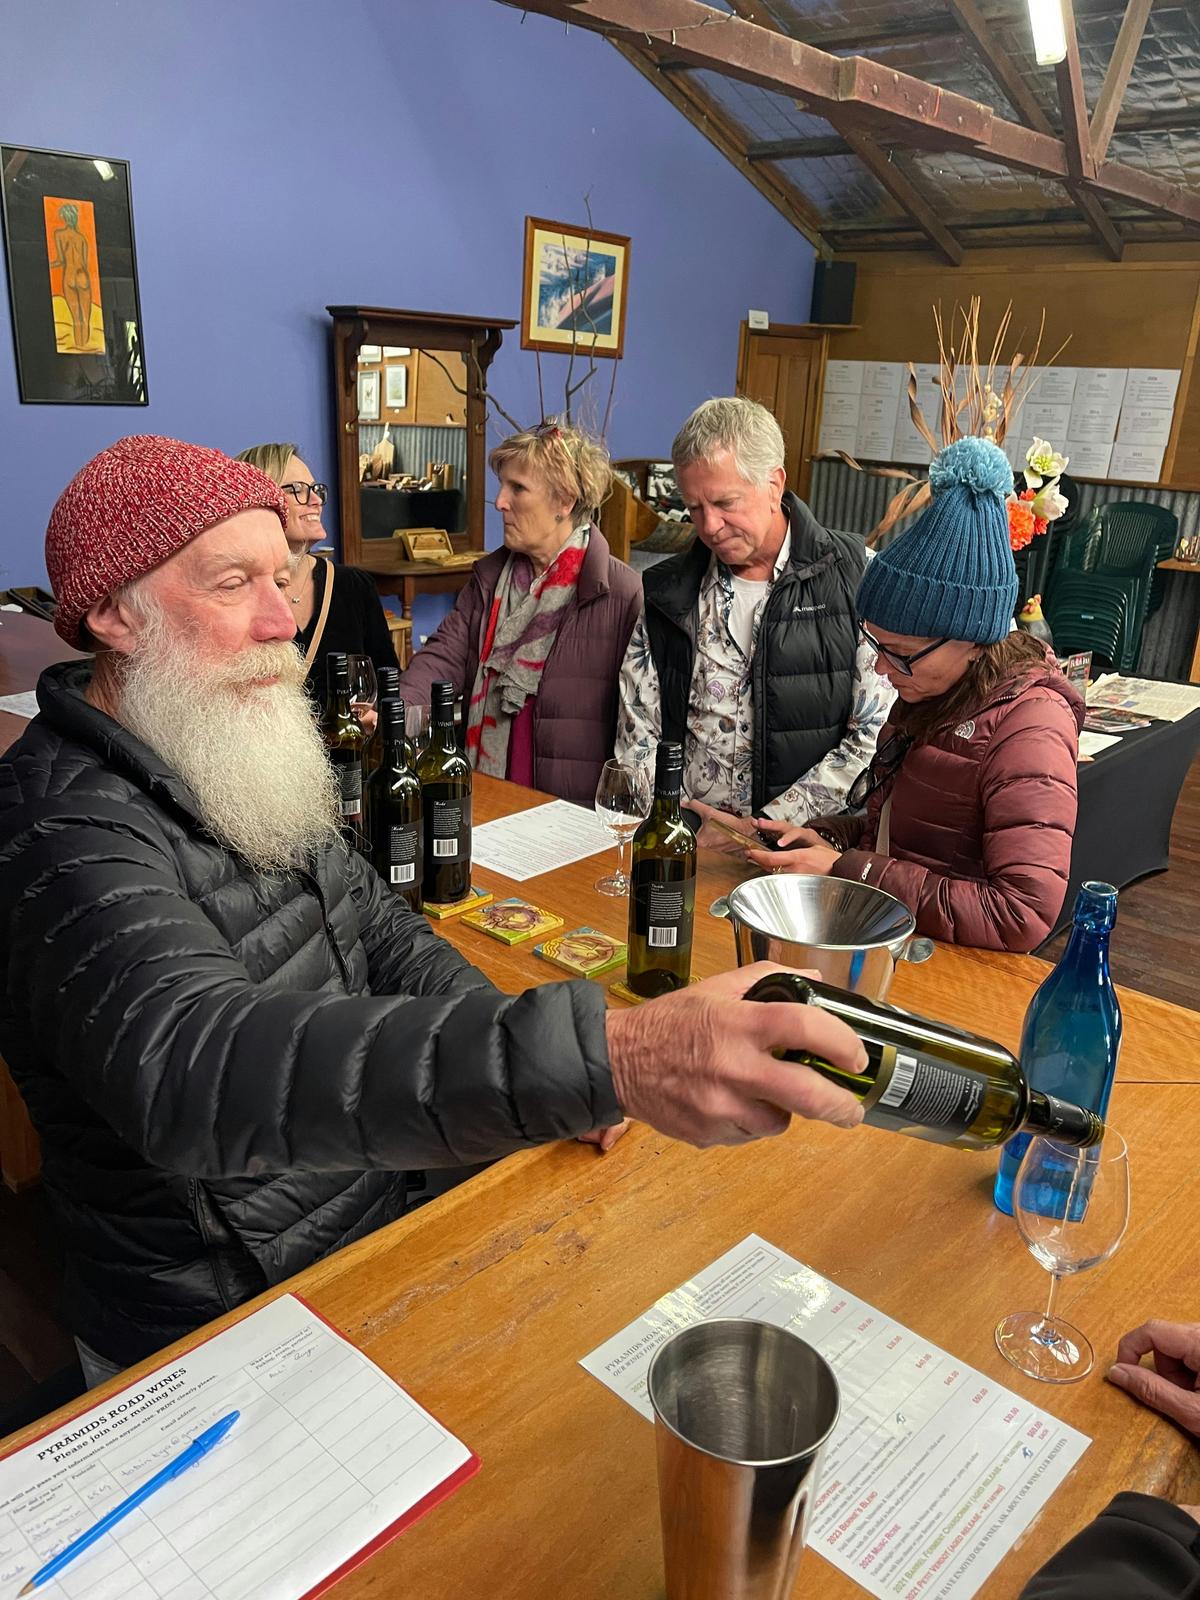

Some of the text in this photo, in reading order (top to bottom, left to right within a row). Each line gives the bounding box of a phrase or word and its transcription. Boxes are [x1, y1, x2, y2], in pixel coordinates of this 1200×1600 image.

[36, 1366, 188, 1461] PYRAMIDS ROAD WINES
[155, 1399, 176, 1414] PRINT
[53, 1378, 186, 1463] Please join our mailing list
[159, 1418, 177, 1431] Email
[812, 1477, 842, 1512] OURVEDRE
[826, 1528, 842, 1546] 2023
[859, 1488, 879, 1510] BLEND
[858, 1551, 876, 1571] 2025
[892, 1576, 909, 1594] 2021
